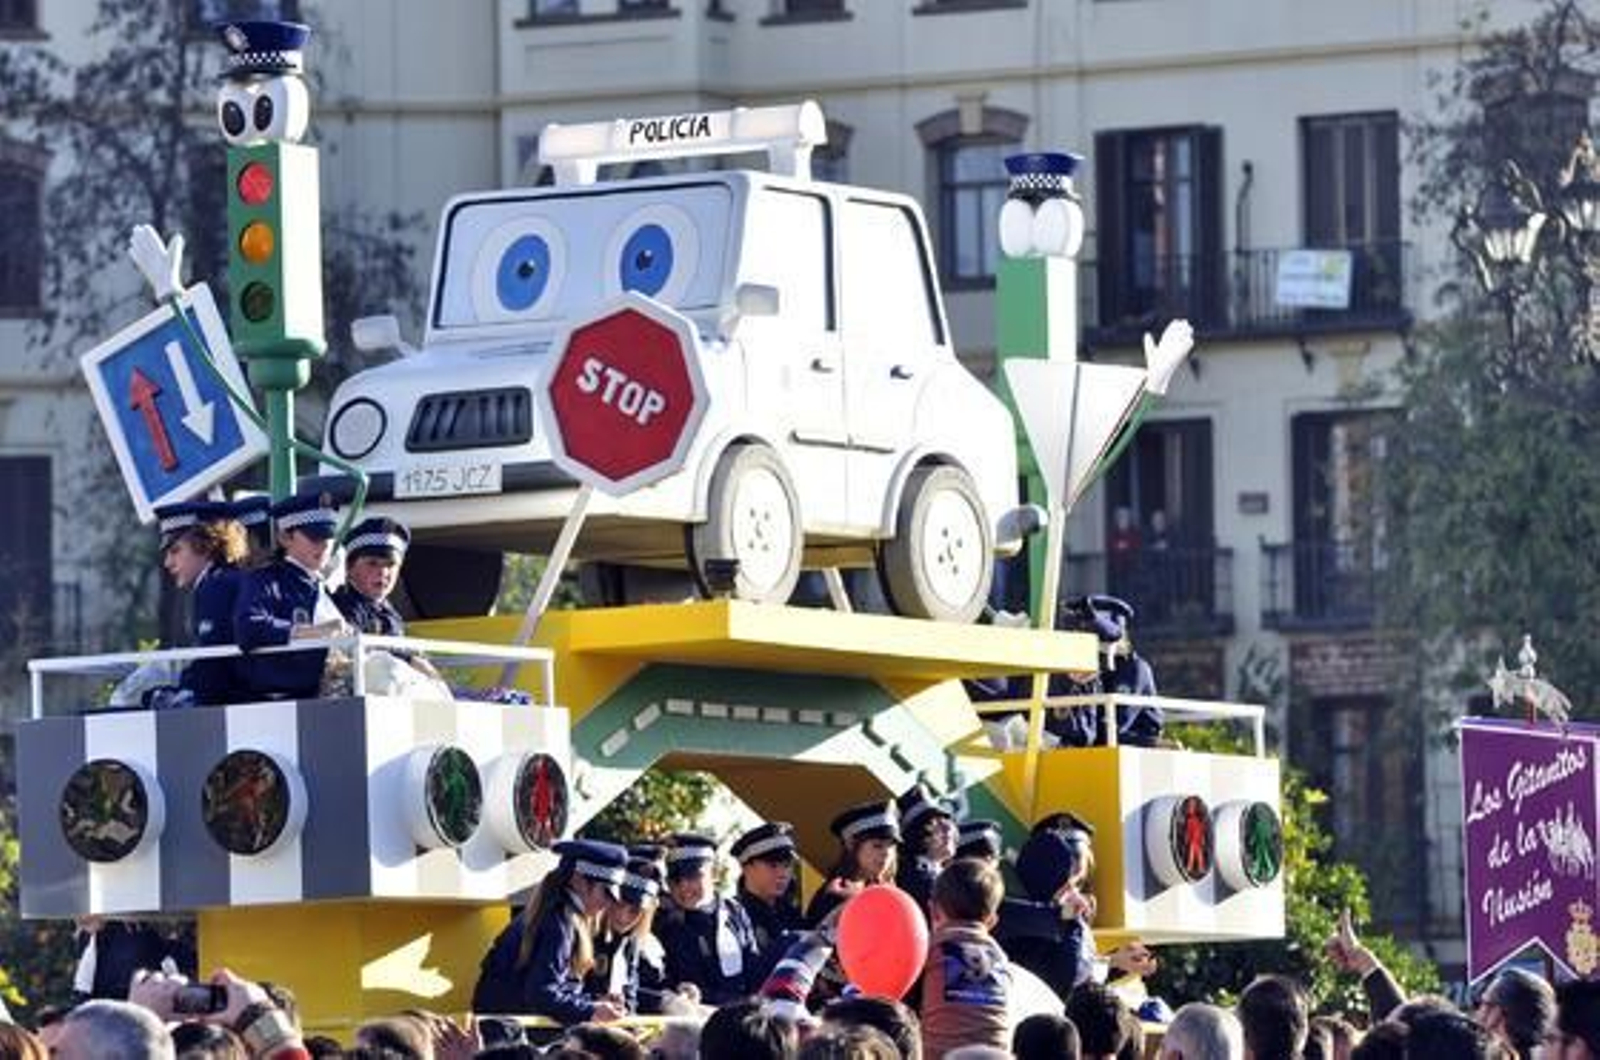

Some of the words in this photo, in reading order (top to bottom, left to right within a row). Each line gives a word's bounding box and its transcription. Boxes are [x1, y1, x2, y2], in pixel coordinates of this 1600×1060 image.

[575, 357, 666, 425] STOP
[1467, 780, 1504, 823] Los
[1487, 832, 1512, 868] de
[1517, 821, 1537, 856] la
